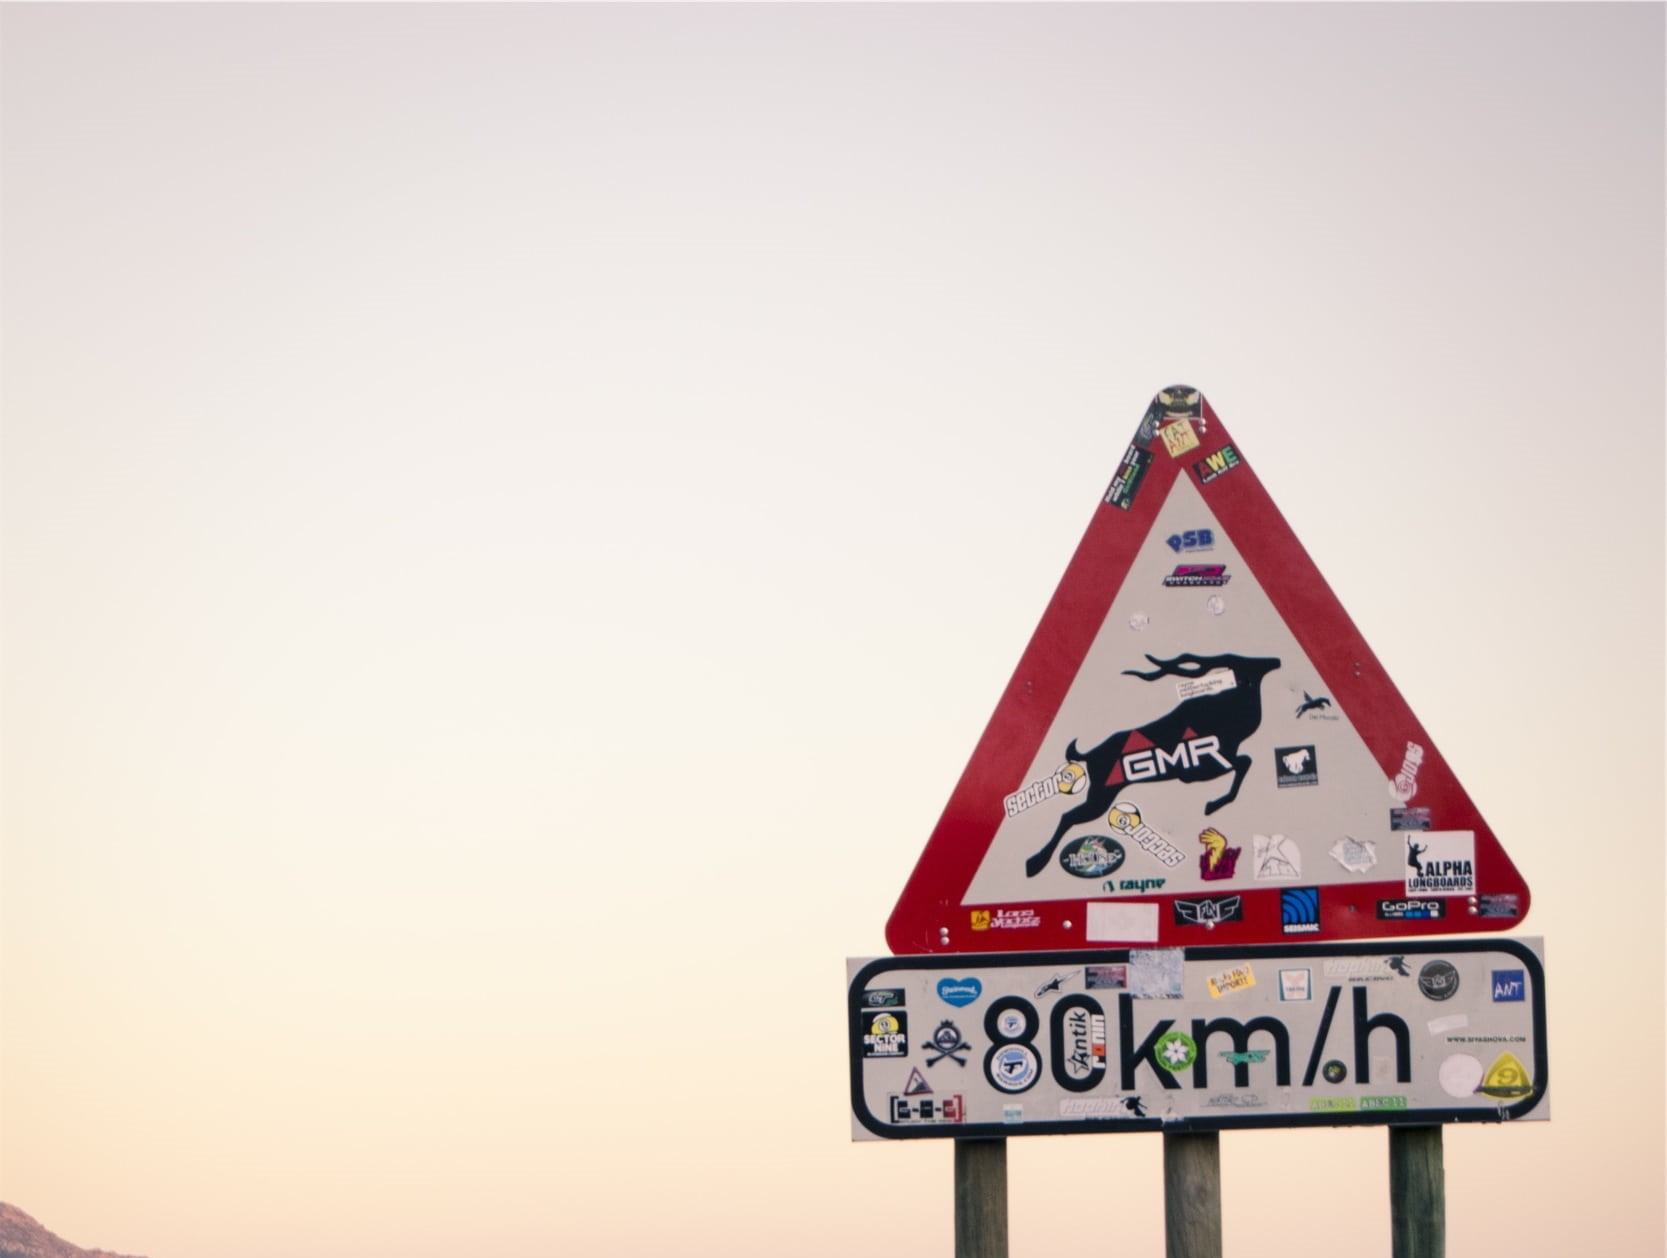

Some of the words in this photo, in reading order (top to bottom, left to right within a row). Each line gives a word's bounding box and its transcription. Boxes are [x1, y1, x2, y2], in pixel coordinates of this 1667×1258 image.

[1199, 445, 1238, 476] AWE
[1122, 735, 1232, 781] GMR
[1006, 771, 1063, 817] sector
[1126, 822, 1185, 868] sector
[1426, 860, 1472, 877] ALPHA
[1120, 878, 1166, 893] rayne
[1408, 876, 1473, 888] LONGBOARDS
[1382, 901, 1440, 912] GoPro
[1283, 922, 1321, 933] SEISMIC
[1494, 981, 1523, 1000] ANT
[863, 1034, 906, 1045] SECTOR
[874, 1043, 899, 1053] NINE
[984, 984, 1411, 1095] 80km/h
[1069, 1011, 1088, 1067] Antik
